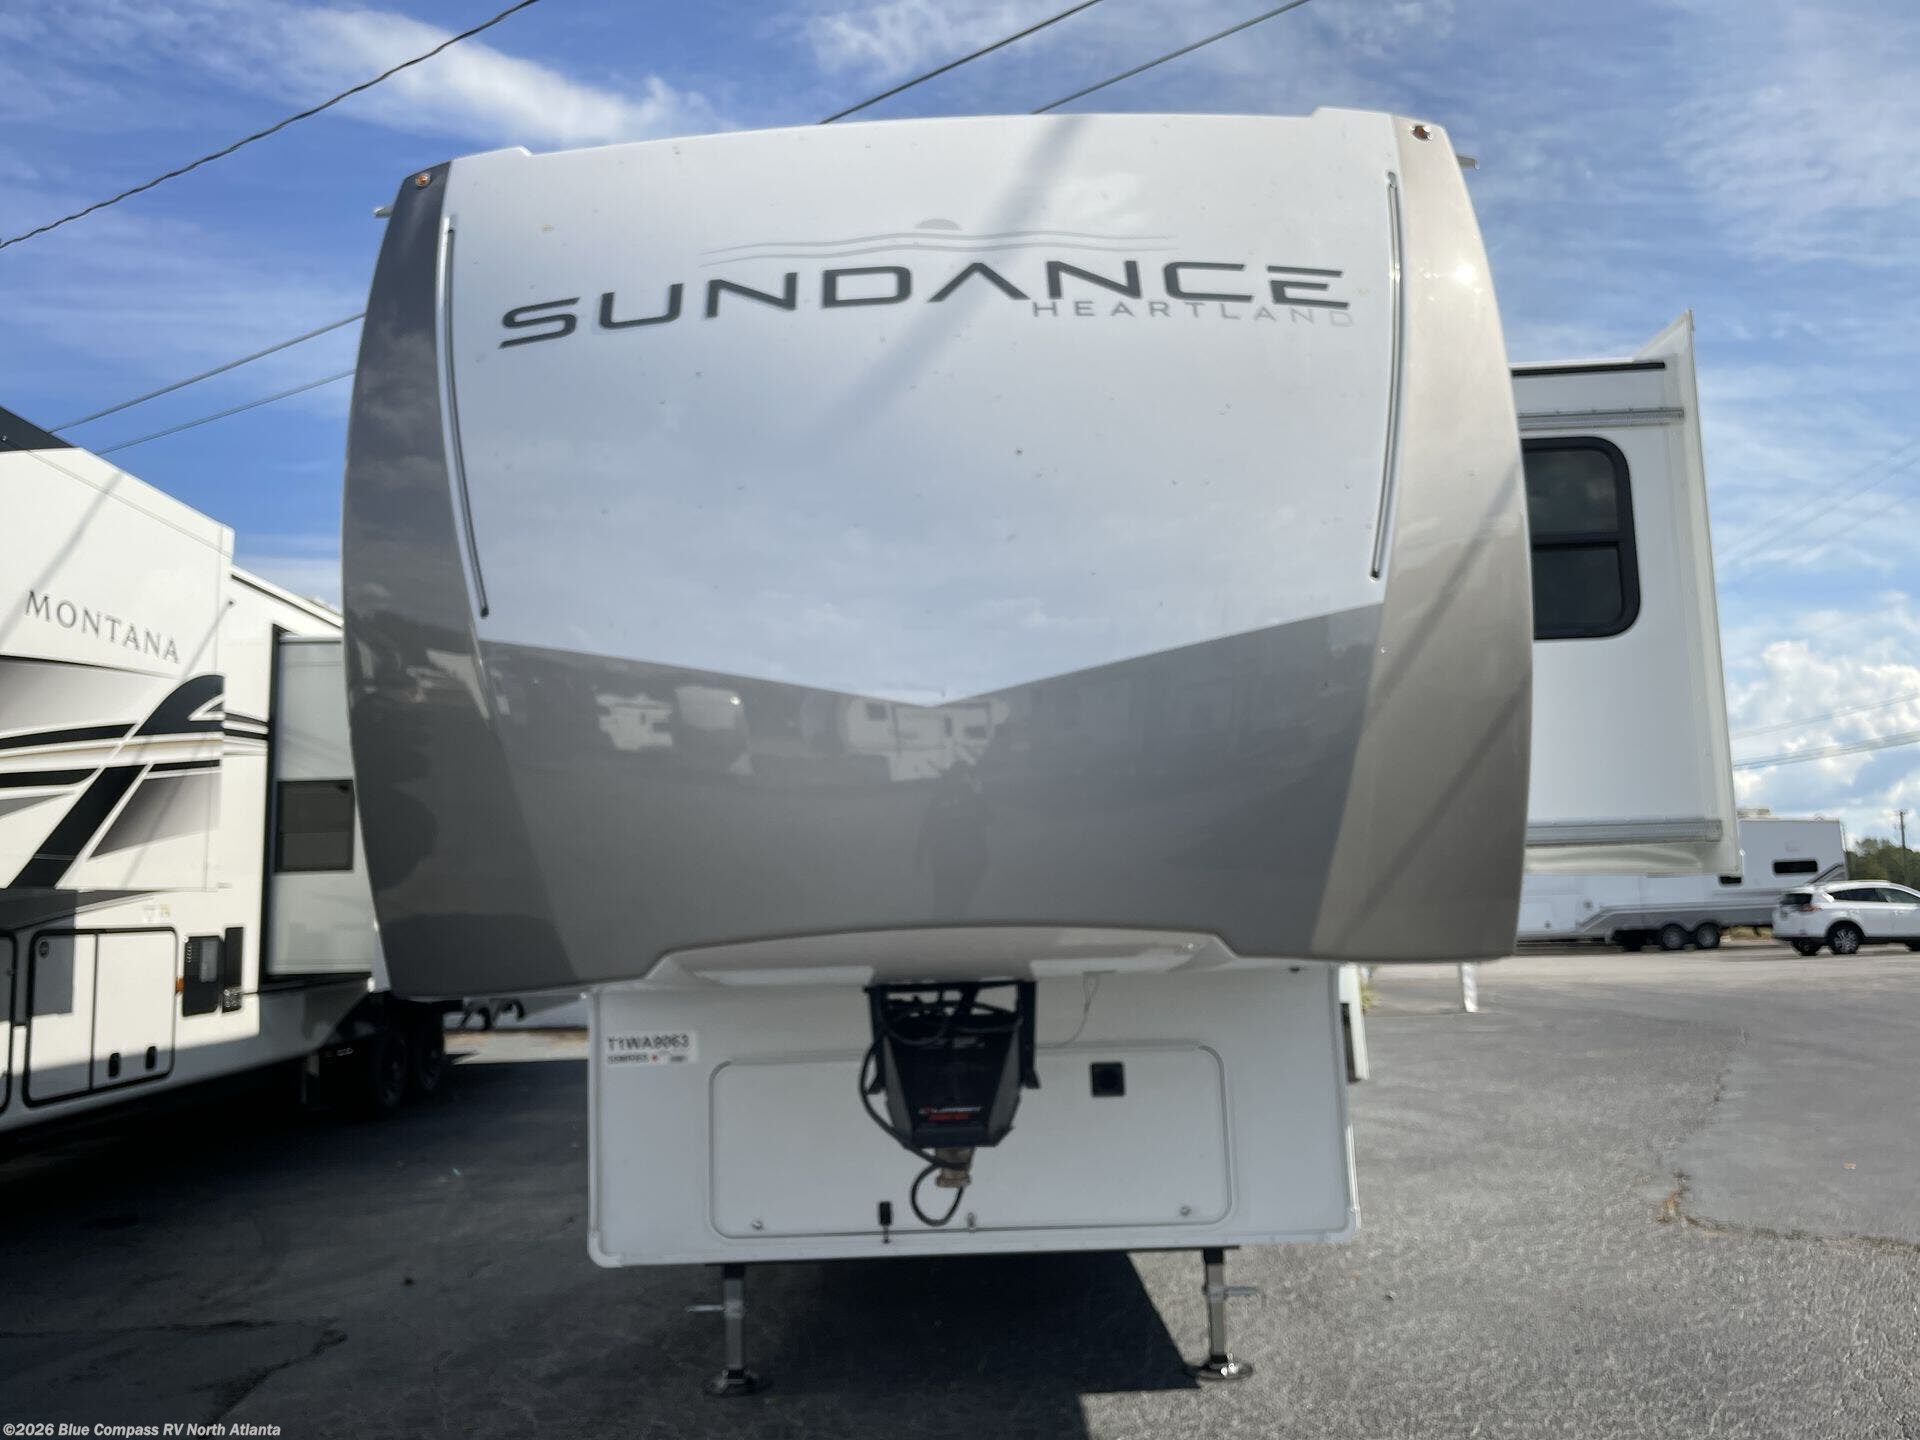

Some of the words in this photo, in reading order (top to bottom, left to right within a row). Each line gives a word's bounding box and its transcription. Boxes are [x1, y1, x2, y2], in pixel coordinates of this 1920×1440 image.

[498, 260, 1350, 348] SUNDANCE
[1033, 300, 1355, 328] HEARTLAND
[25, 590, 180, 664] MONTANA
